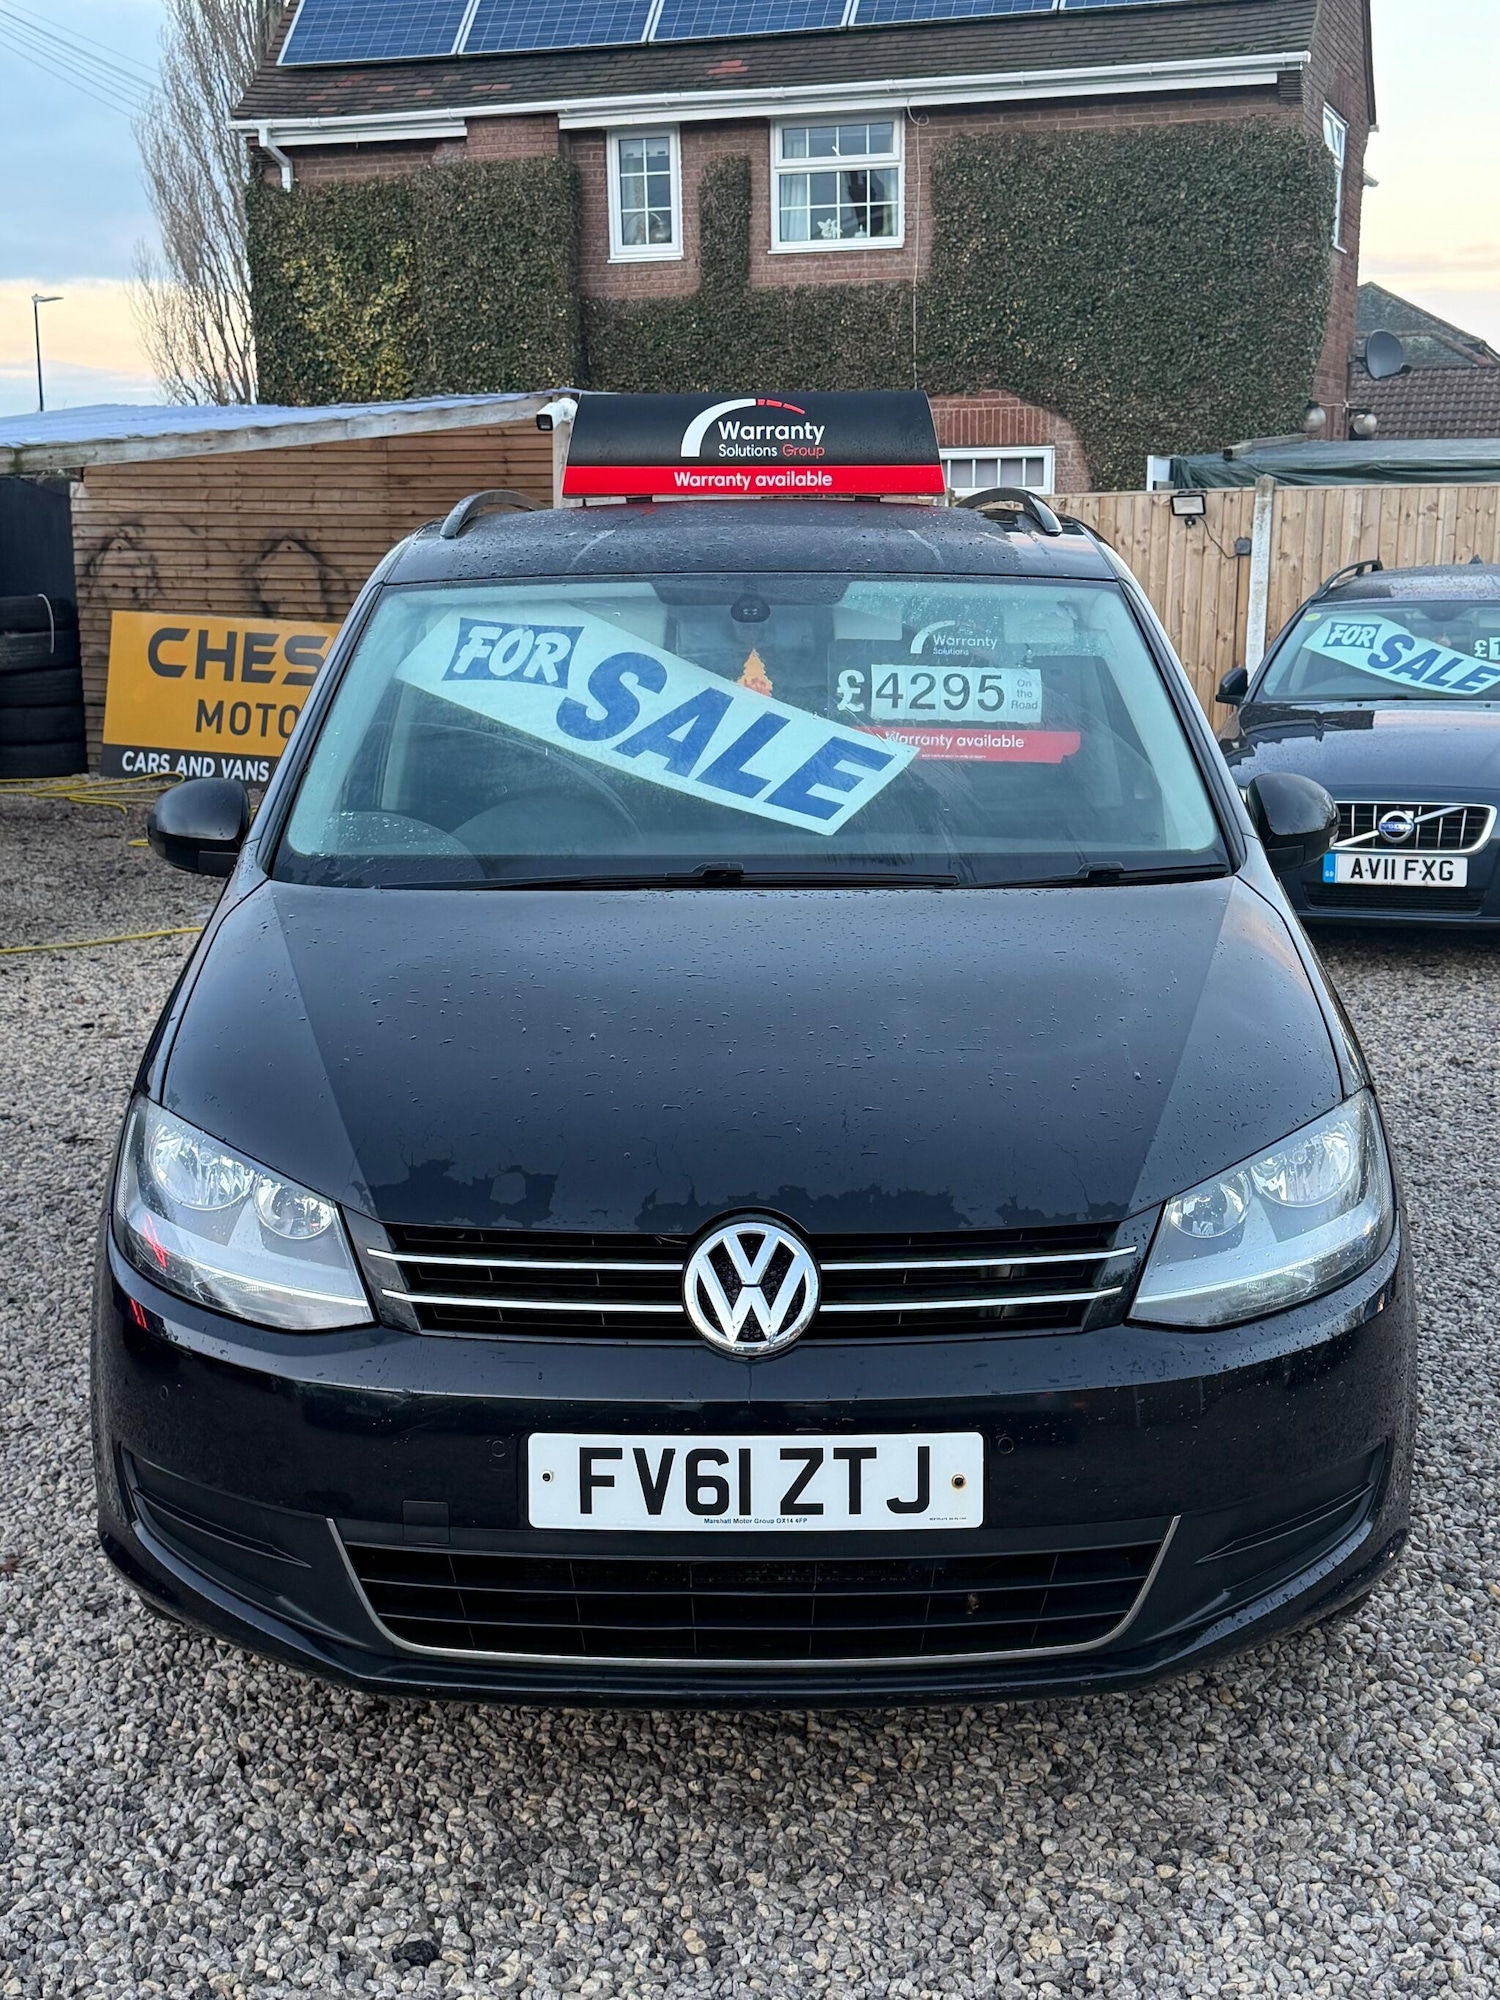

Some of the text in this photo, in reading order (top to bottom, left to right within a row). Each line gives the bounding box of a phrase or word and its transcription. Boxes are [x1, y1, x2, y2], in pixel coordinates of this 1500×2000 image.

[718, 421, 825, 445] Warranty
[718, 443, 825, 459] Solutions Group
[674, 470, 832, 490] Warranty available
[933, 634, 998, 650] Warranty
[1327, 624, 1377, 648] FOR
[148, 627, 328, 686] CHES
[452, 625, 572, 685] FOR
[932, 646, 969, 656] Solutions
[1367, 634, 1500, 691] SALE
[836, 669, 1005, 712] £4295
[1017, 678, 1032, 688] On
[1017, 689, 1033, 698] the
[1010, 700, 1039, 710] Road
[195, 698, 300, 739] MOTO
[556, 651, 898, 821] SALE
[885, 731, 1025, 750] Warranty available
[122, 750, 269, 782] CARS AND VANS
[1350, 858, 1454, 881] AV11 FXG
[579, 1446, 930, 1516] FV61 ZTJ
